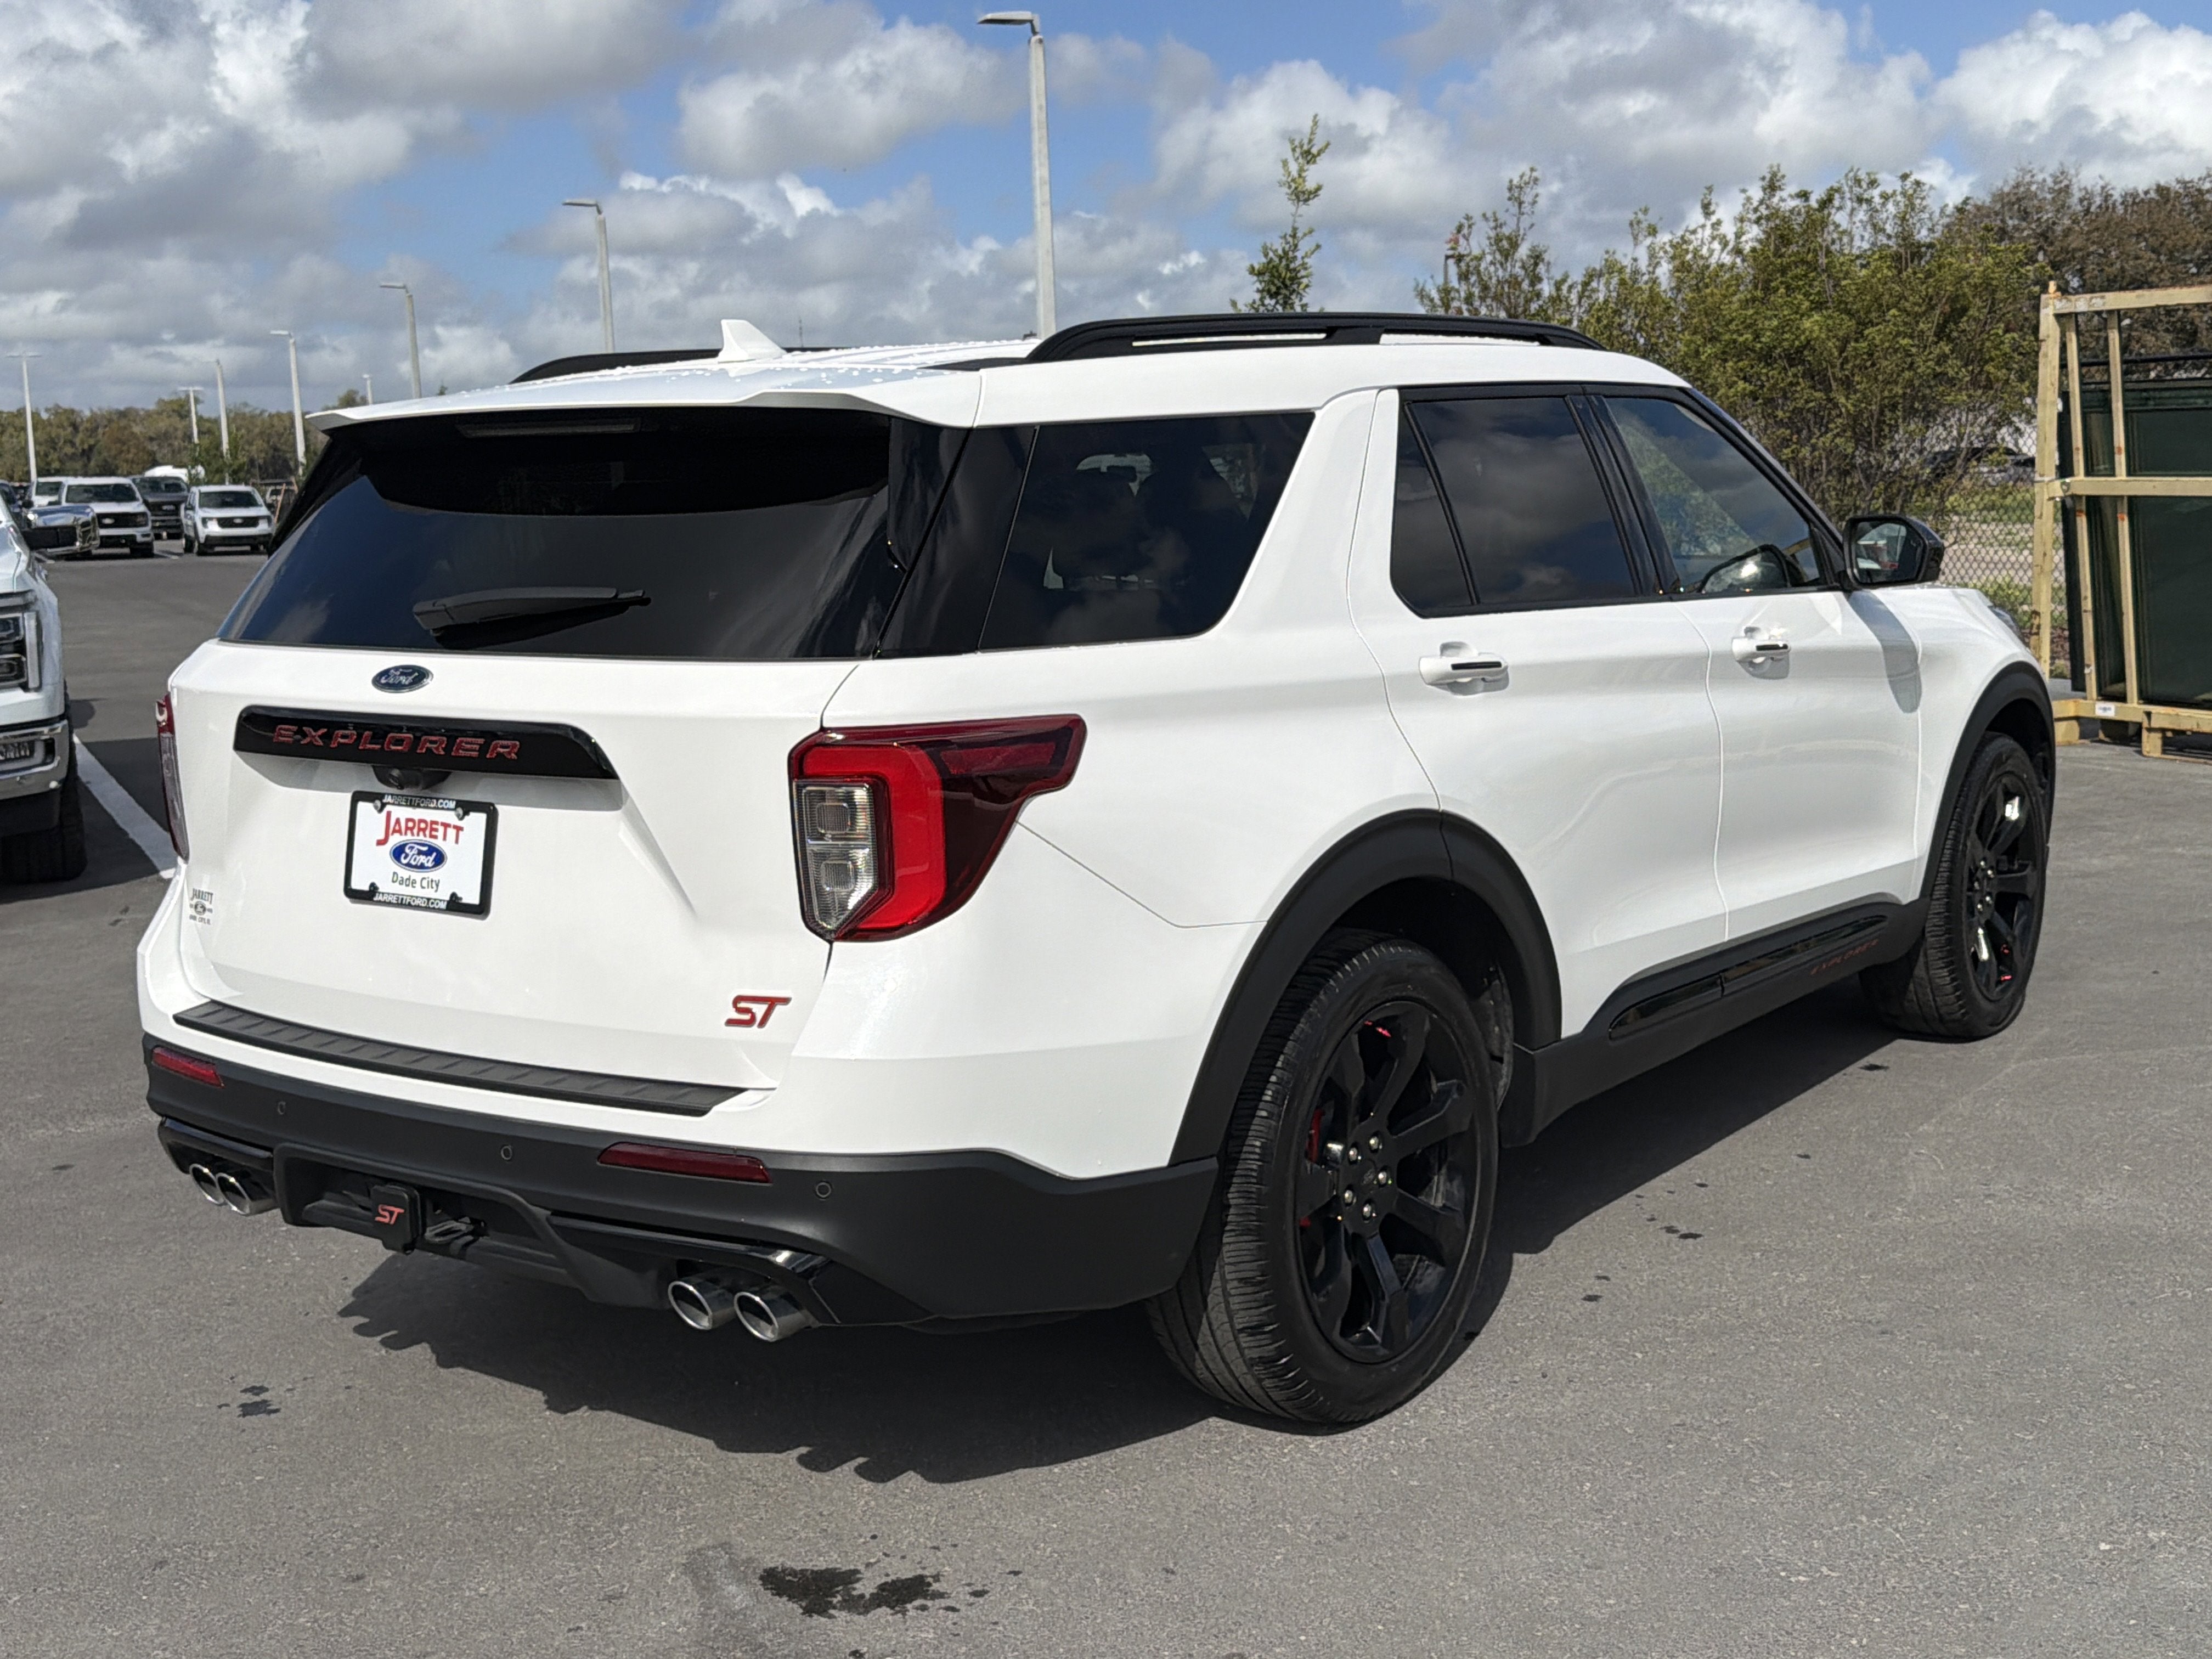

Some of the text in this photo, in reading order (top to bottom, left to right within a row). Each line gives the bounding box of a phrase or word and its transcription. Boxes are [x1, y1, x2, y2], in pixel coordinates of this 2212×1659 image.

[380, 668, 419, 685] Ford
[272, 725, 521, 759] EXPLORER
[382, 795, 456, 810] JARRETTFORD.COM
[376, 810, 464, 846] JARRETT
[400, 843, 435, 867] Ford
[392, 871, 440, 893] Dade City
[373, 893, 447, 910] JARRETTFORD.COM
[725, 995, 792, 1029] ST
[375, 1204, 405, 1224] ST
